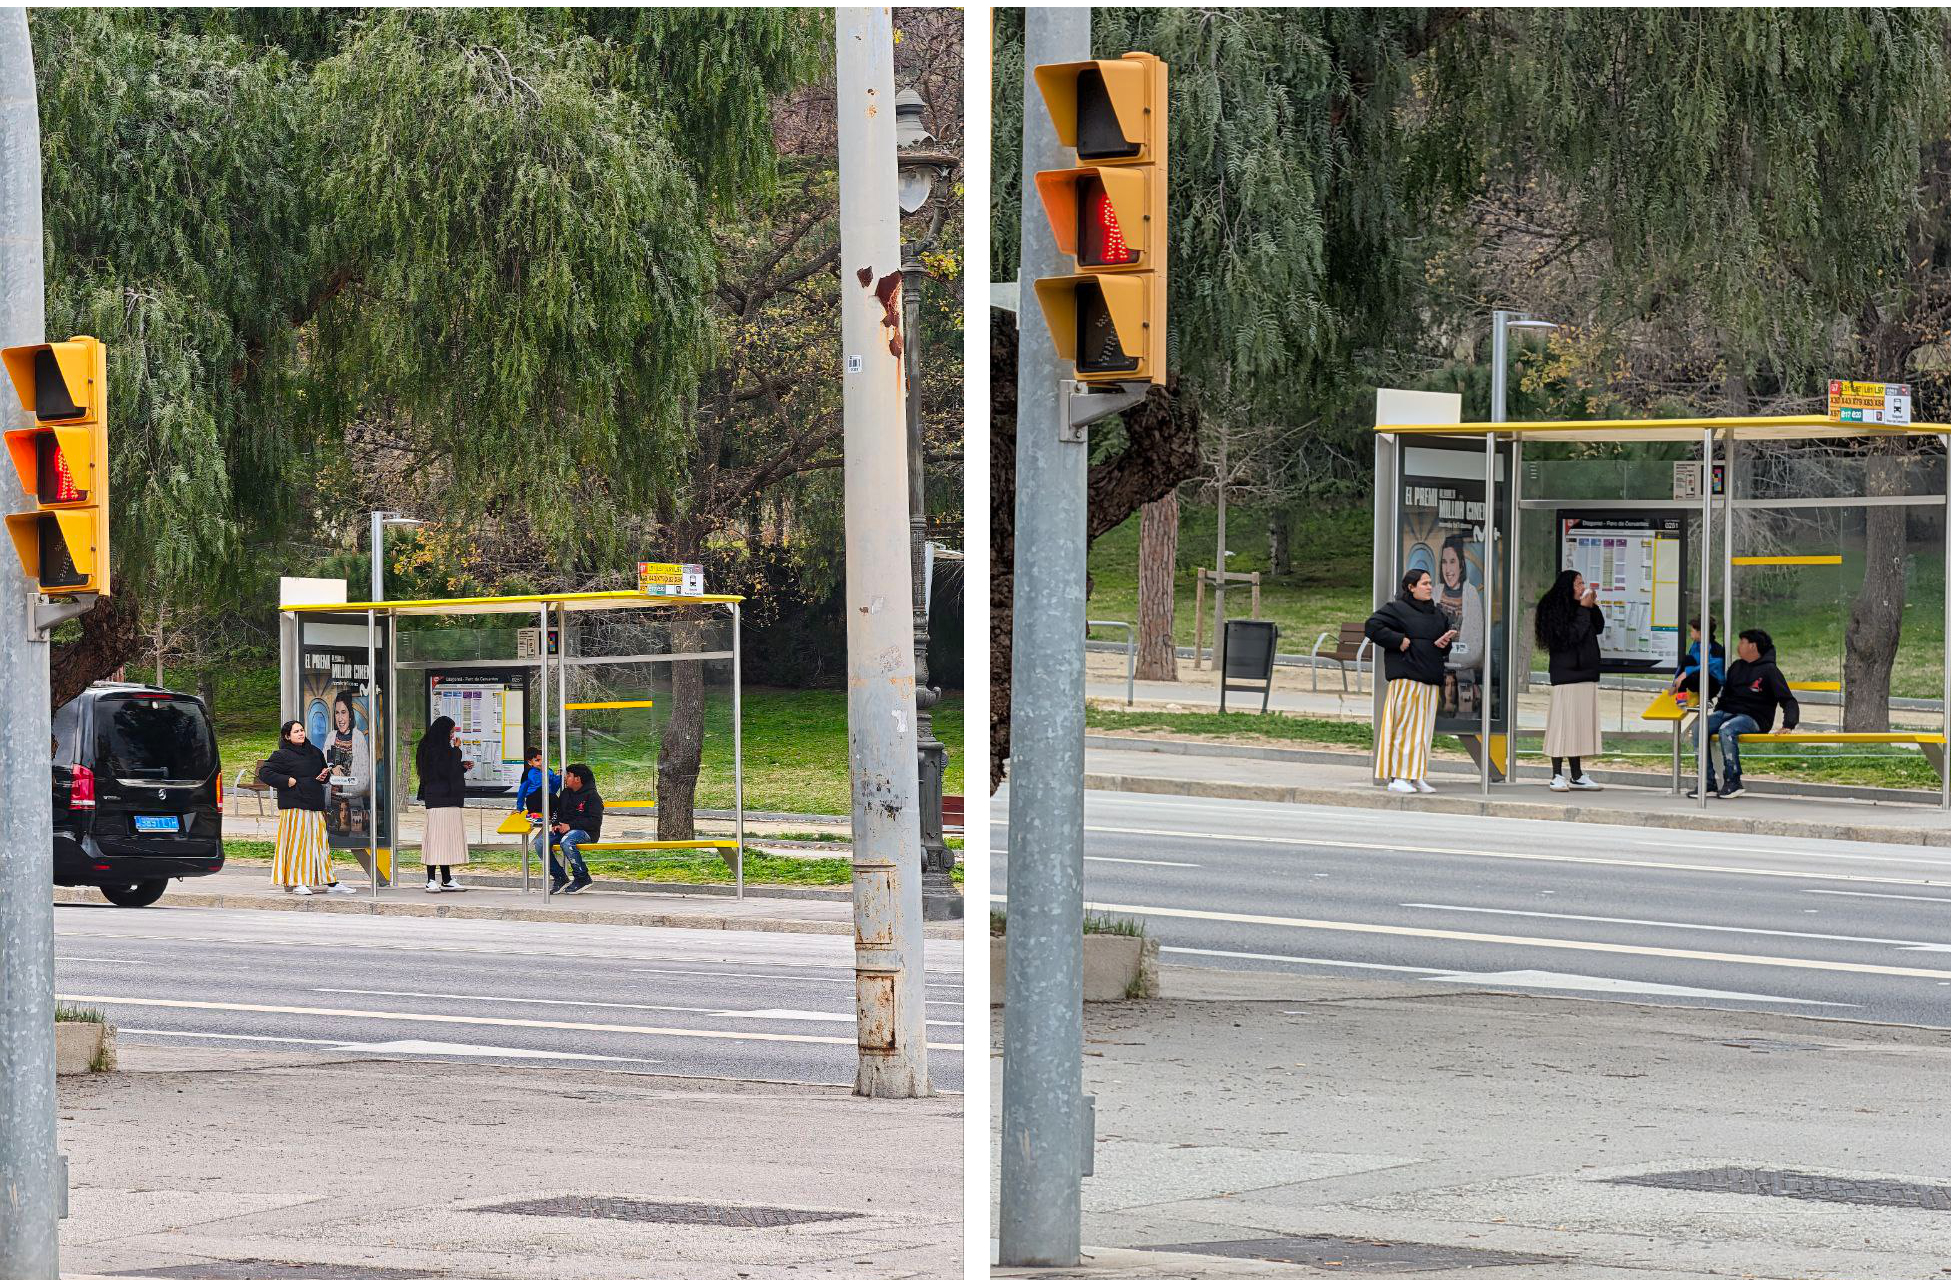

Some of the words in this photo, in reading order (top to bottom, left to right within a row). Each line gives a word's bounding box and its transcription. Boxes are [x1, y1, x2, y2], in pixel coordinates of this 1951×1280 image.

[1405, 486, 1413, 506] EL
[1414, 487, 1438, 507] PREMI
[1439, 500, 1466, 520] MILLOR
[1466, 501, 1486, 521] CINE
[304, 654, 311, 669] EL
[312, 654, 331, 670] PREMI
[332, 664, 352, 679] MILLOR
